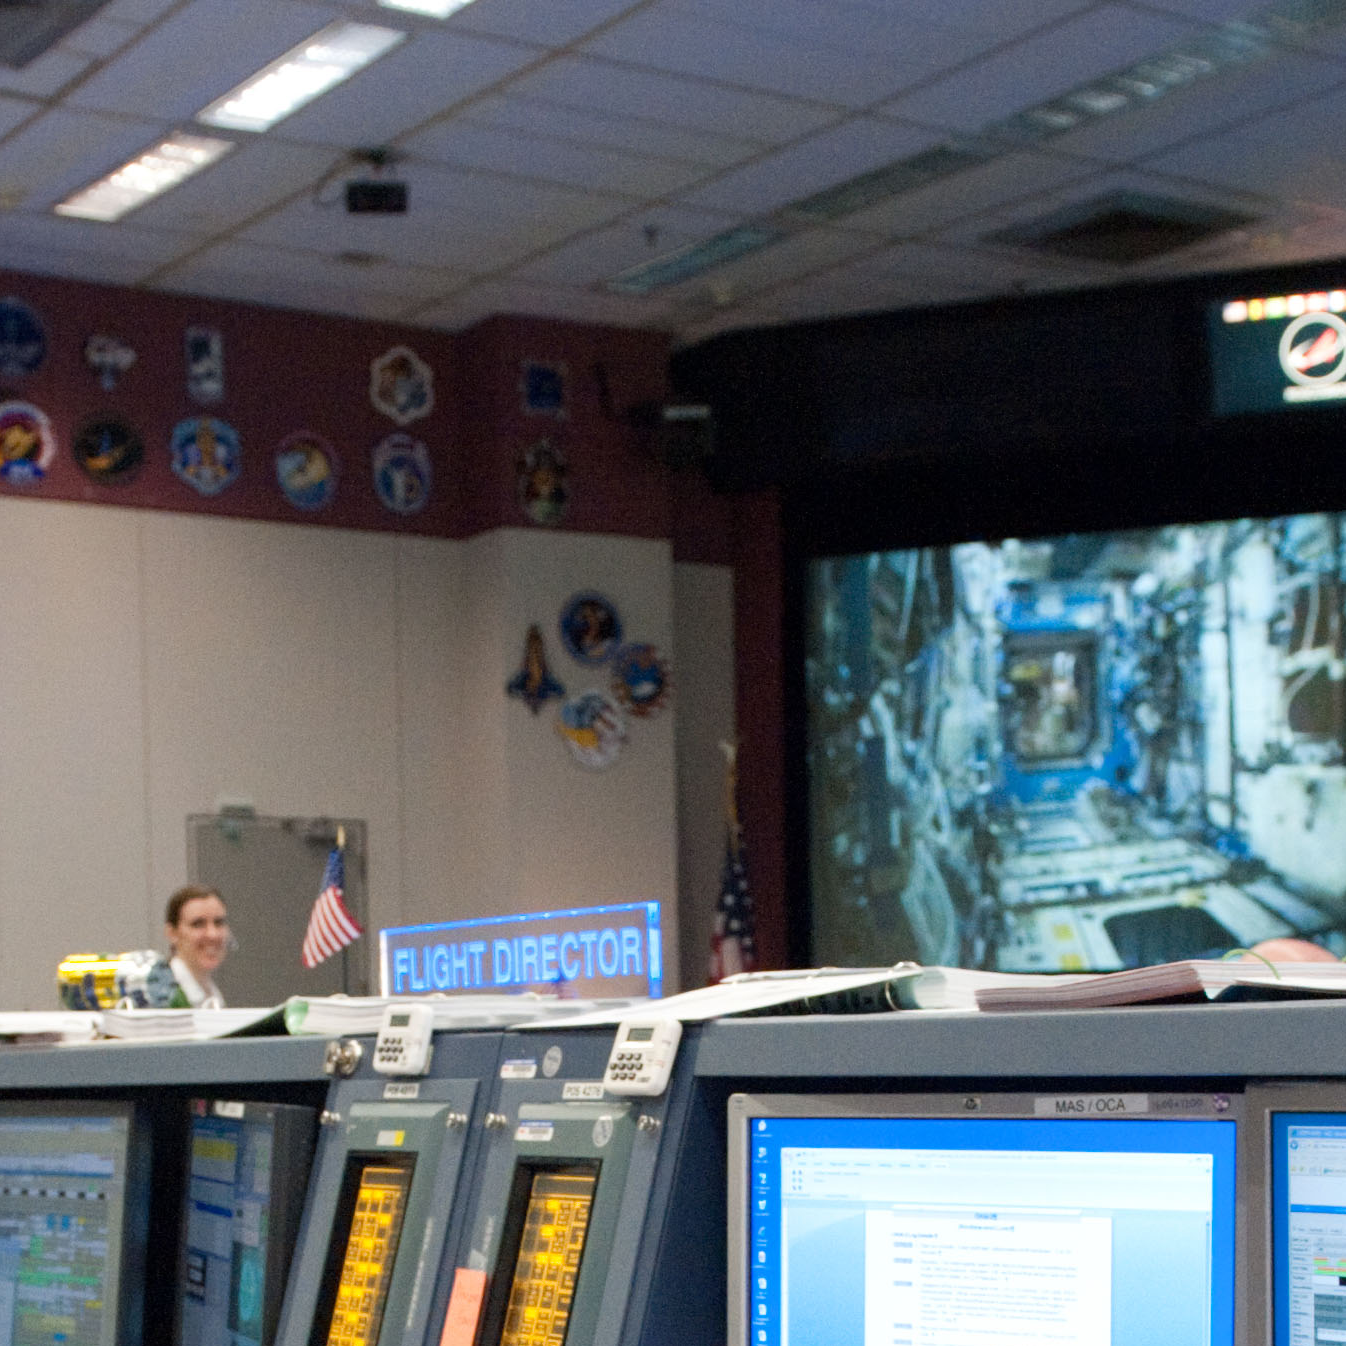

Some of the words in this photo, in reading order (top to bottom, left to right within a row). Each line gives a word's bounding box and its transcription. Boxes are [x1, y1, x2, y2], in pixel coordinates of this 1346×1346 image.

[394, 940, 486, 992] FLIGHT
[492, 927, 642, 984] DIRECTOR
[1055, 1100, 1086, 1112] MAS
[1095, 1098, 1126, 1112] OCA
